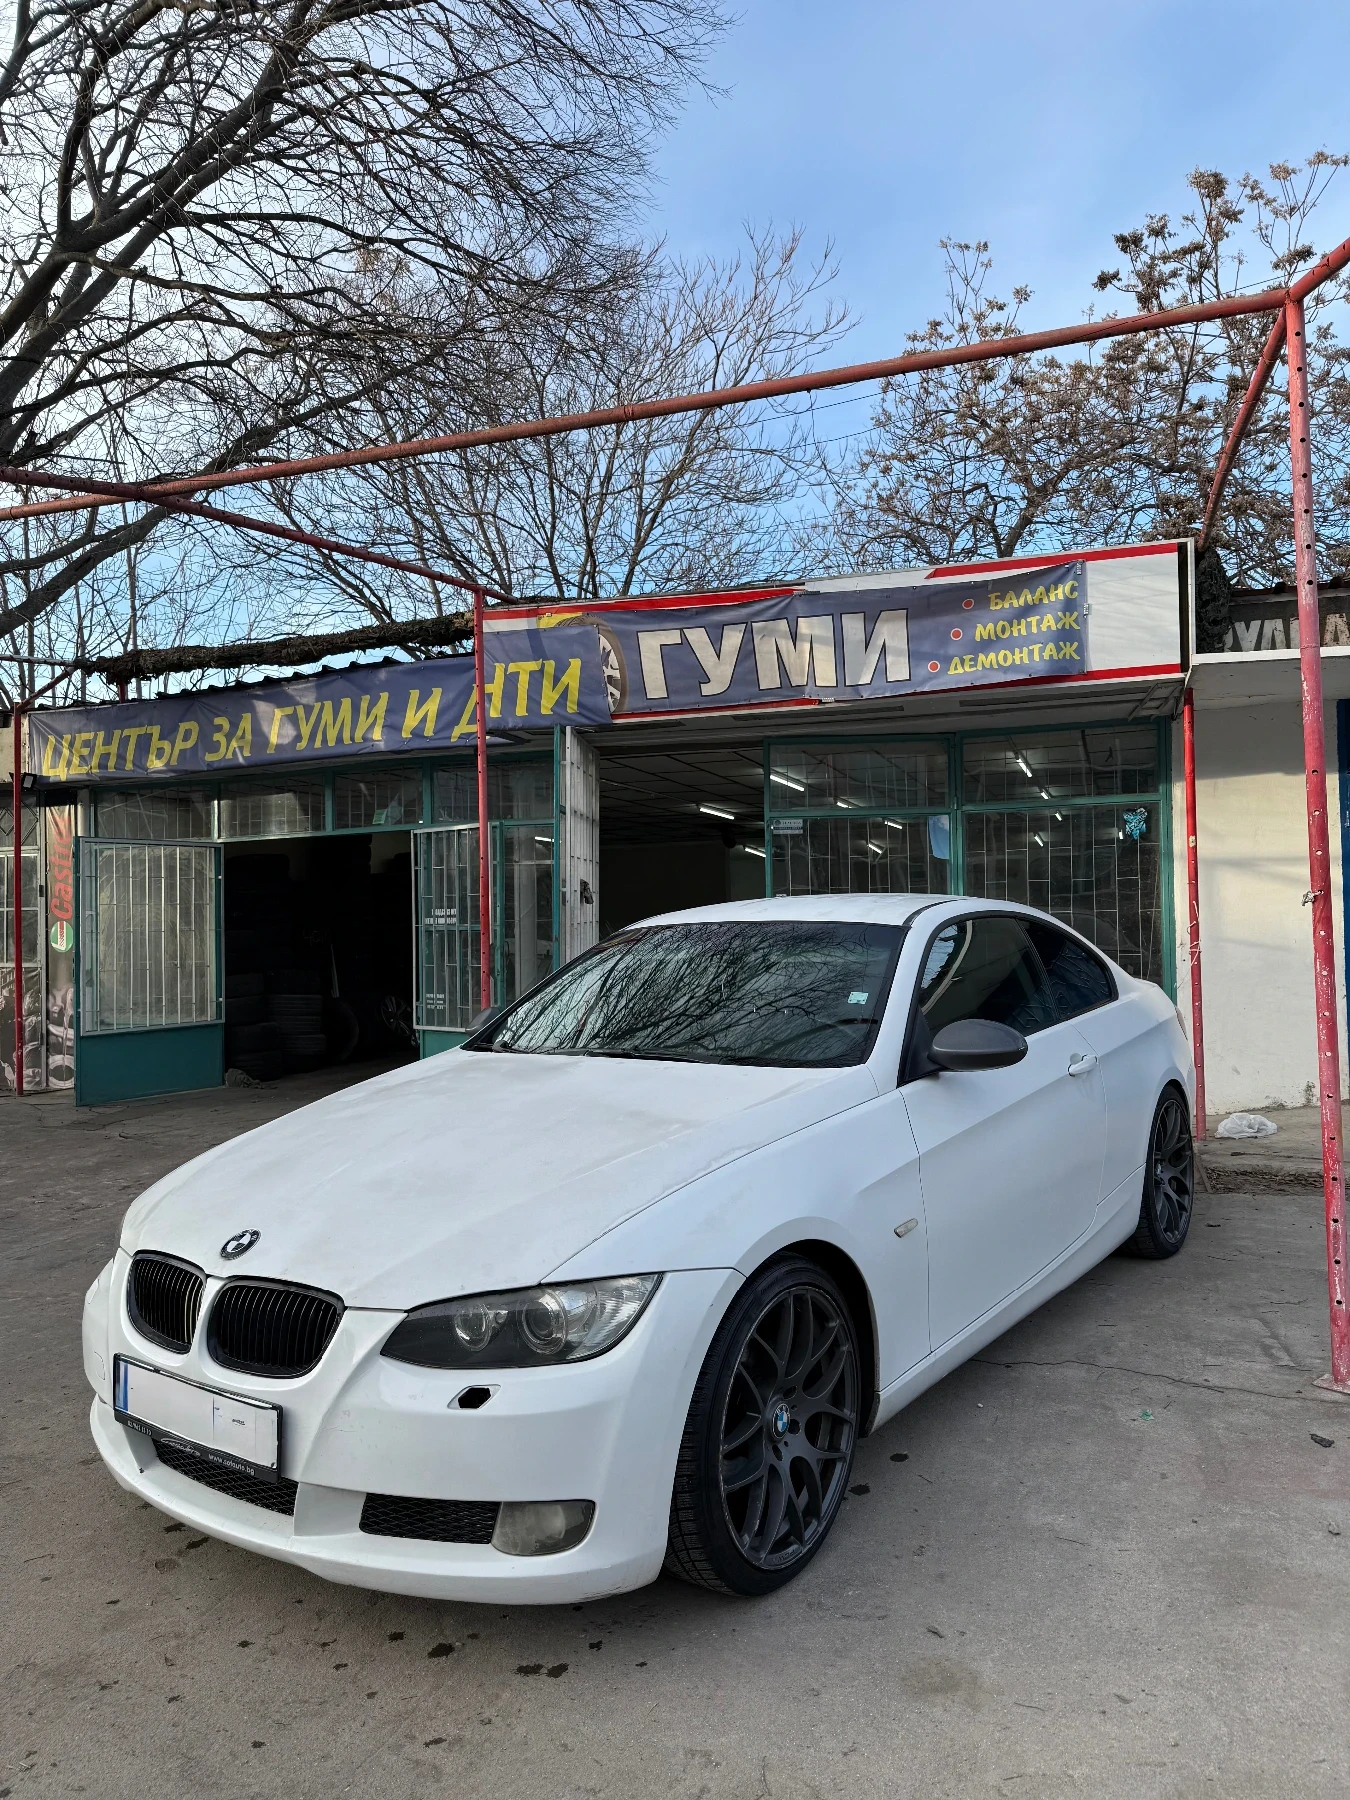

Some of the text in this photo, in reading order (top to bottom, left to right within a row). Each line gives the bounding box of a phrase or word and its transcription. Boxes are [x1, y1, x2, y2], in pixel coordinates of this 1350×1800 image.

[988, 580, 1079, 611] БАЛАНС
[975, 611, 1081, 642] МОНТАЖ
[636, 608, 911, 700] ГУМИ
[947, 641, 1081, 675] ДЕМОНТАЖ
[42, 721, 200, 781] ЦЕНТЪР
[204, 713, 252, 762] ЗА
[266, 691, 389, 753] ГУМИ
[401, 687, 443, 738] И
